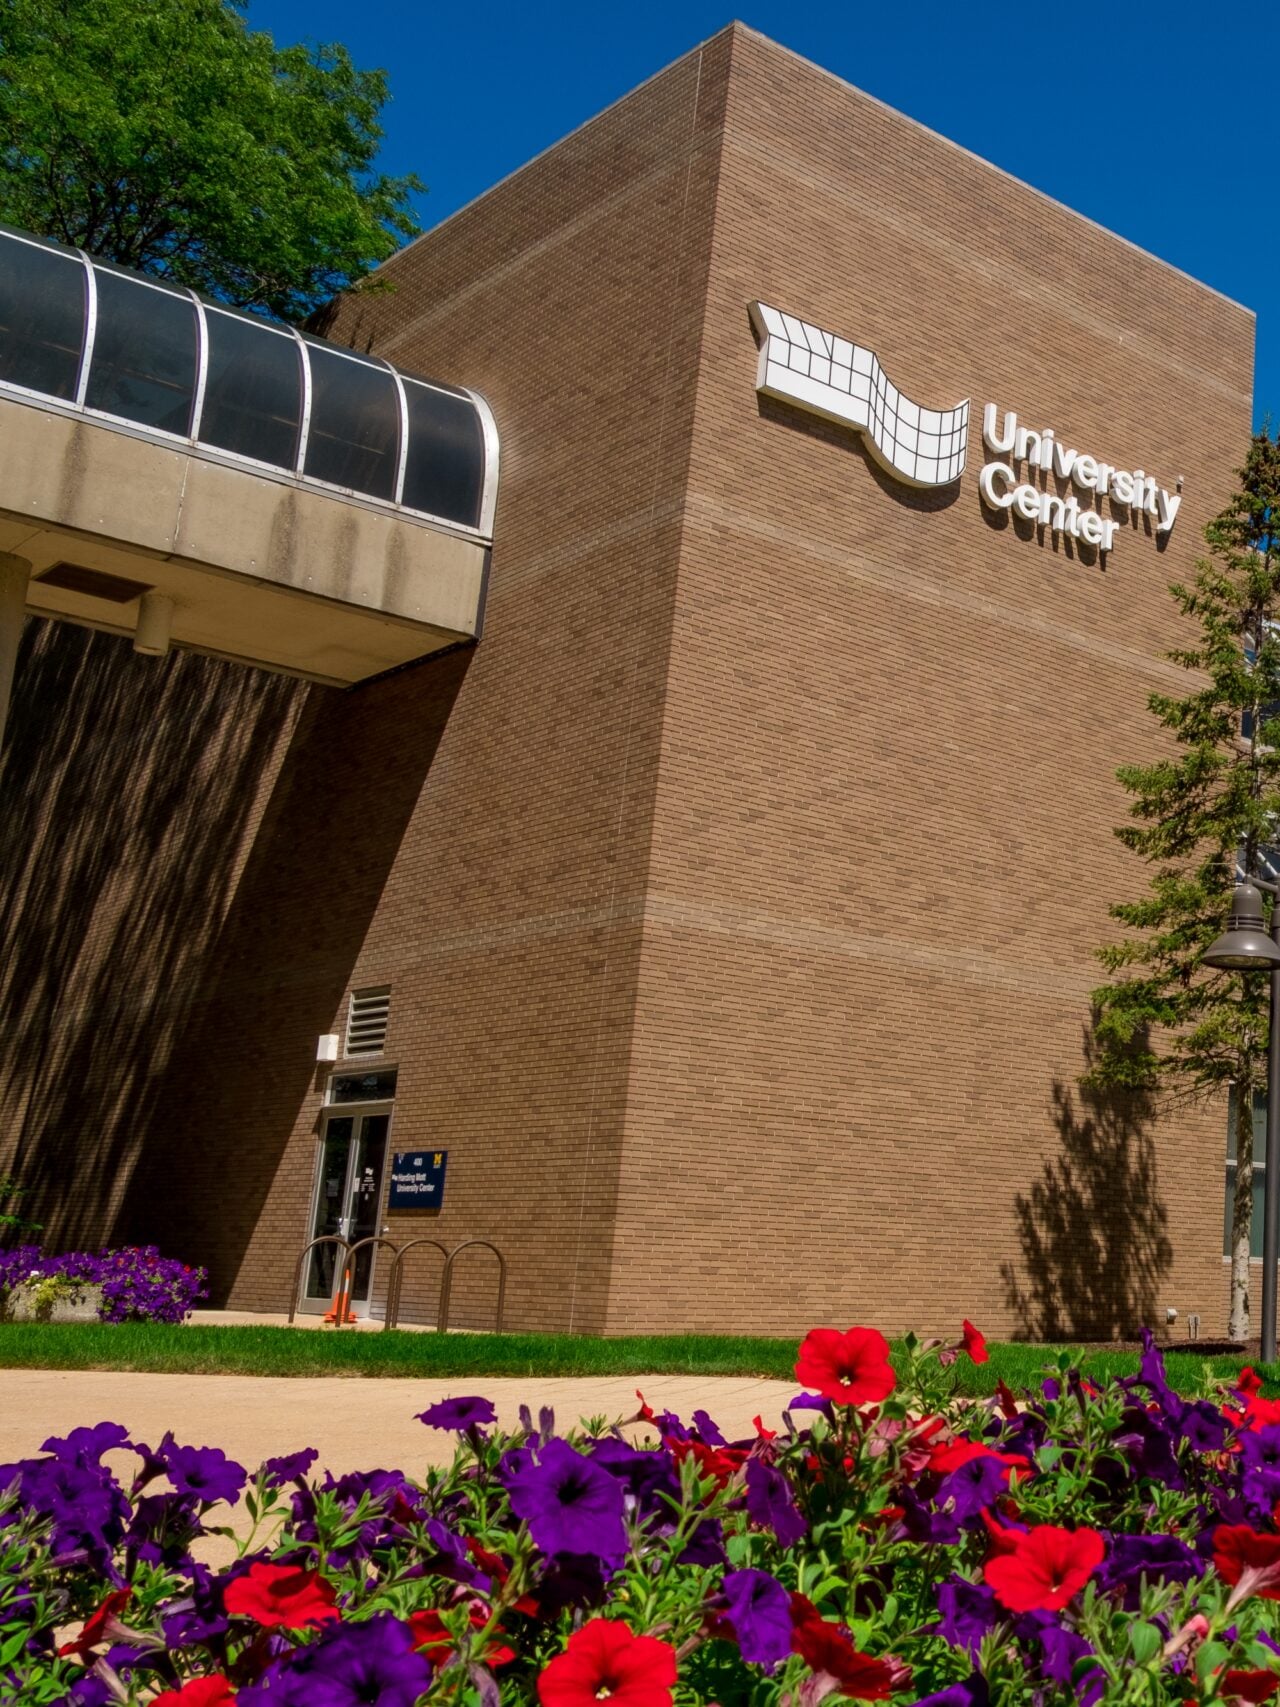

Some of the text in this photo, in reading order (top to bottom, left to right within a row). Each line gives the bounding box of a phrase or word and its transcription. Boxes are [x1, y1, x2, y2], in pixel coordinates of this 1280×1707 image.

[979, 461, 1120, 550] Center
[983, 403, 1182, 531] University
[397, 1183, 435, 1194] University Center
